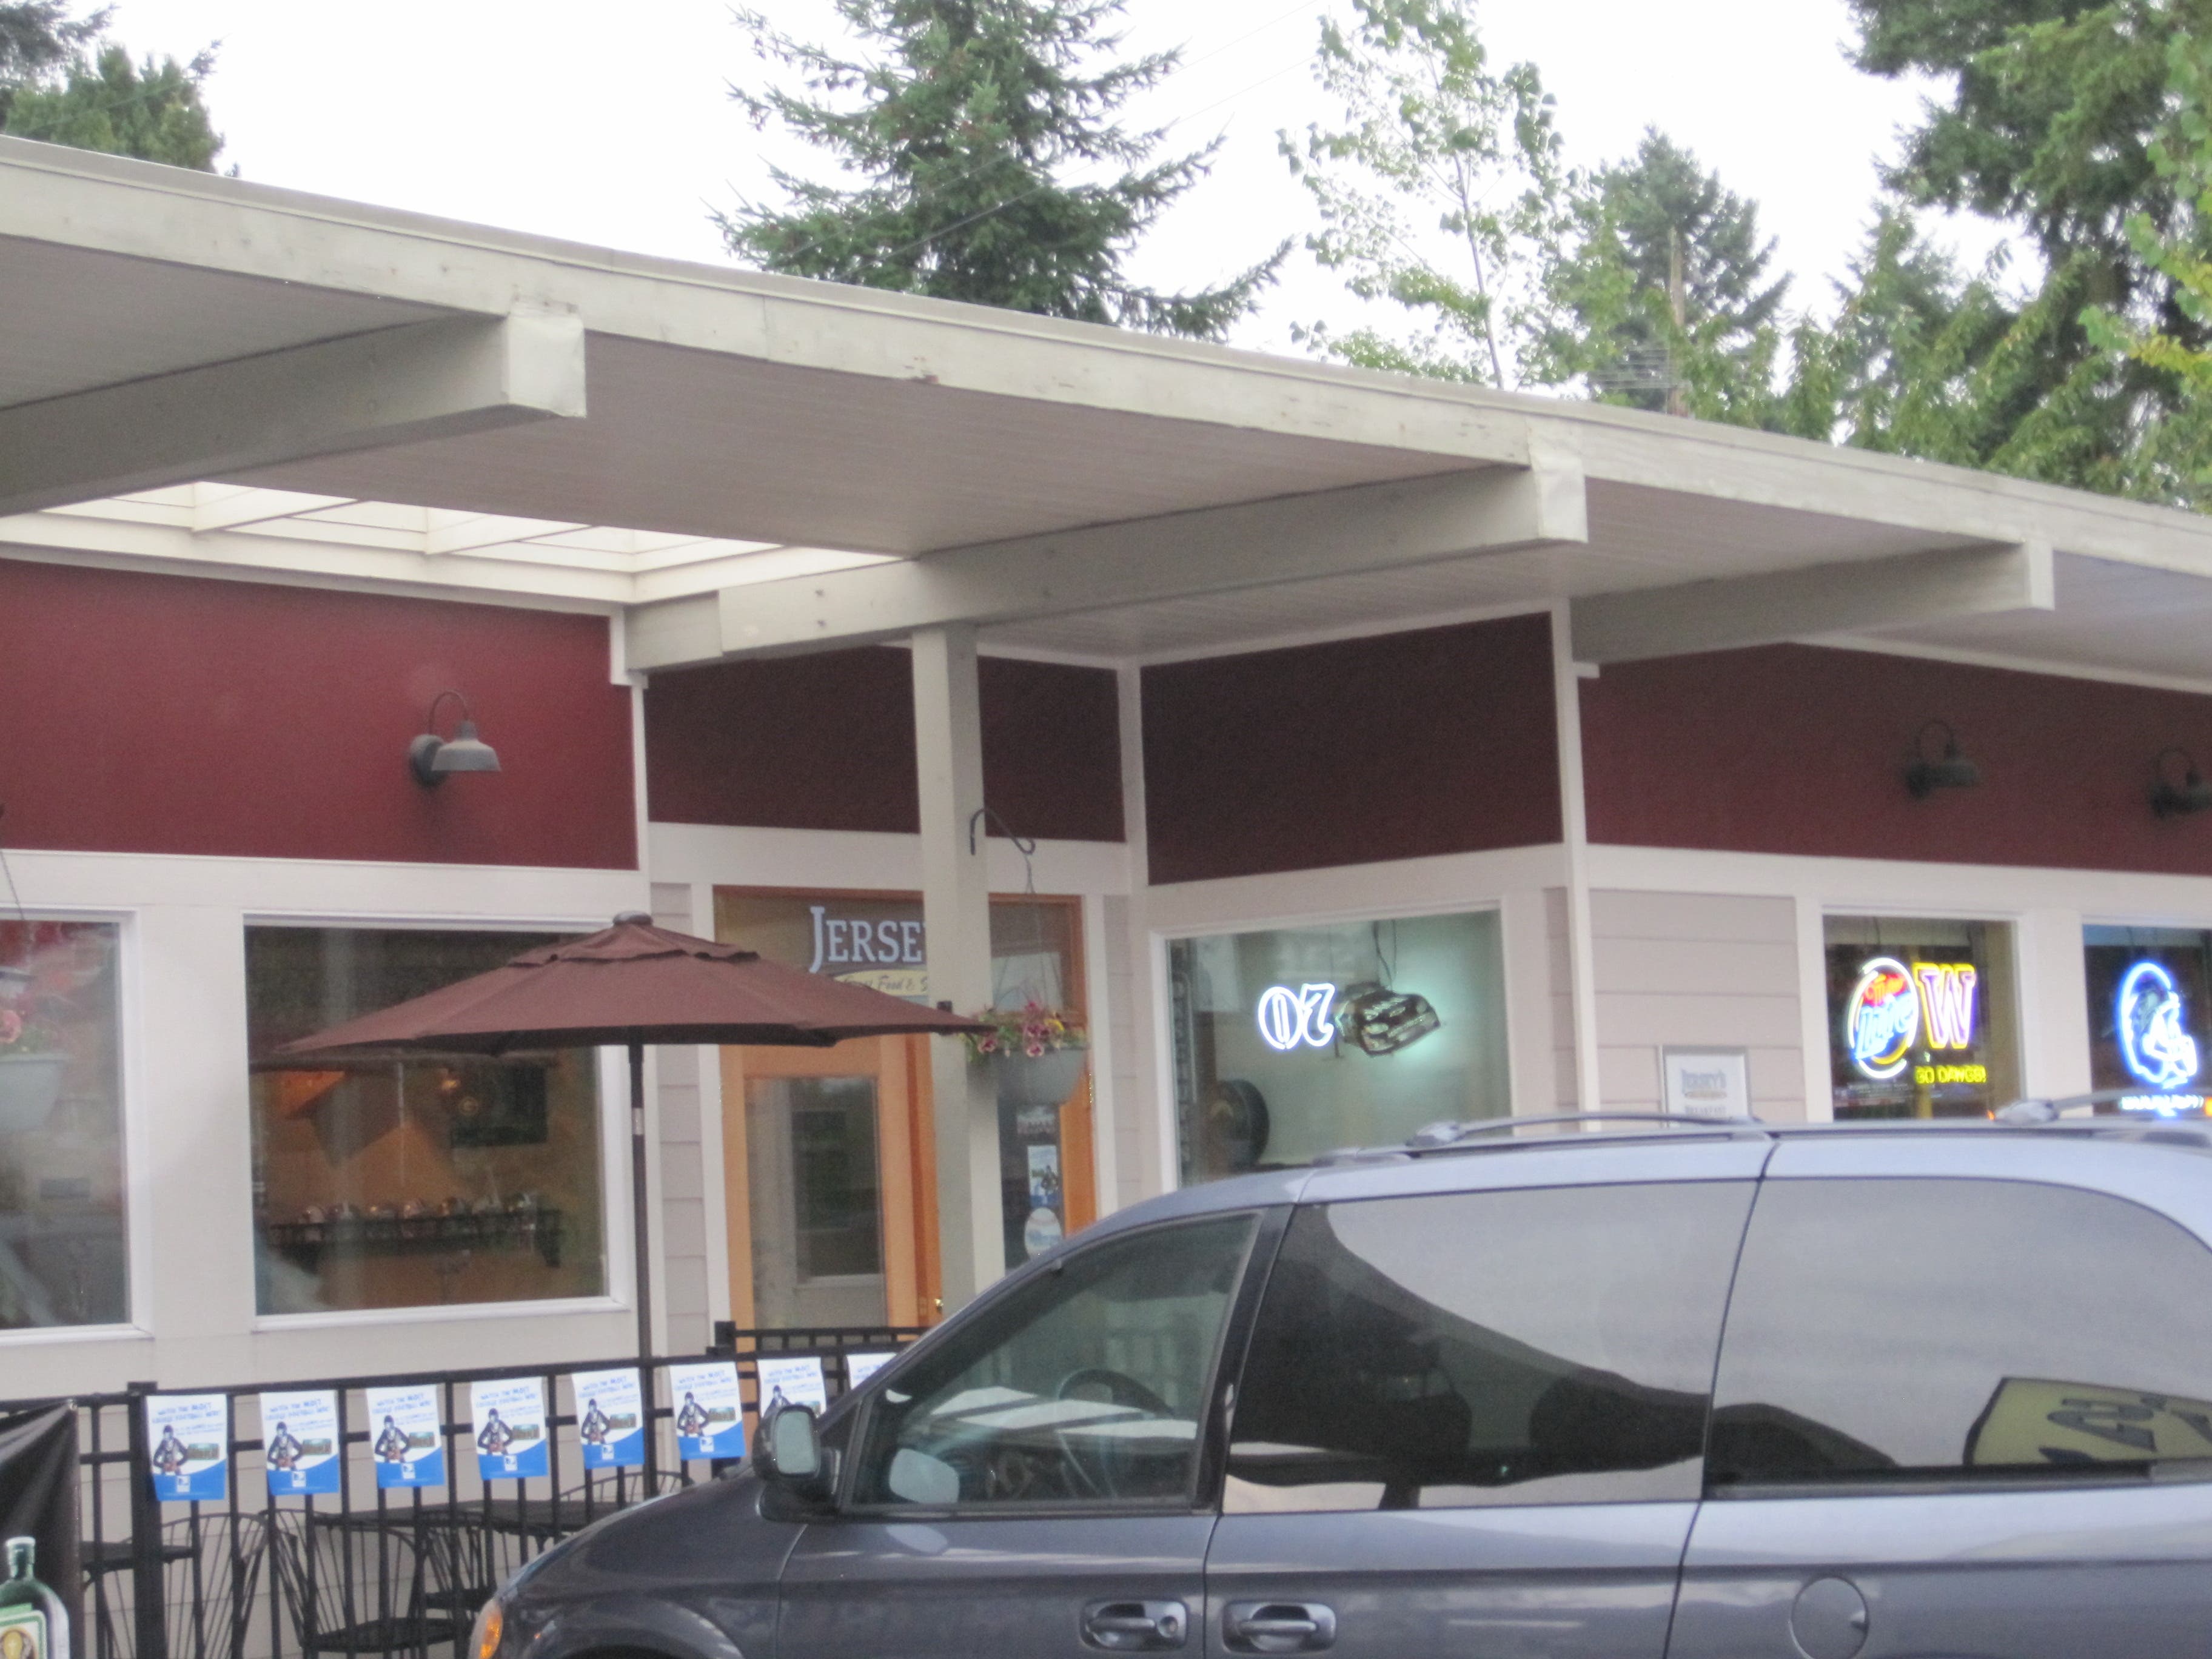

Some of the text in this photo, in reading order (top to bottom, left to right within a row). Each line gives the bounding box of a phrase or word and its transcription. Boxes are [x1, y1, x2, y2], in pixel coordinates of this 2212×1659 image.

[809, 906, 927, 973] JERSE
[1911, 962, 1976, 1050] W
[1915, 1065, 1934, 1084] GO
